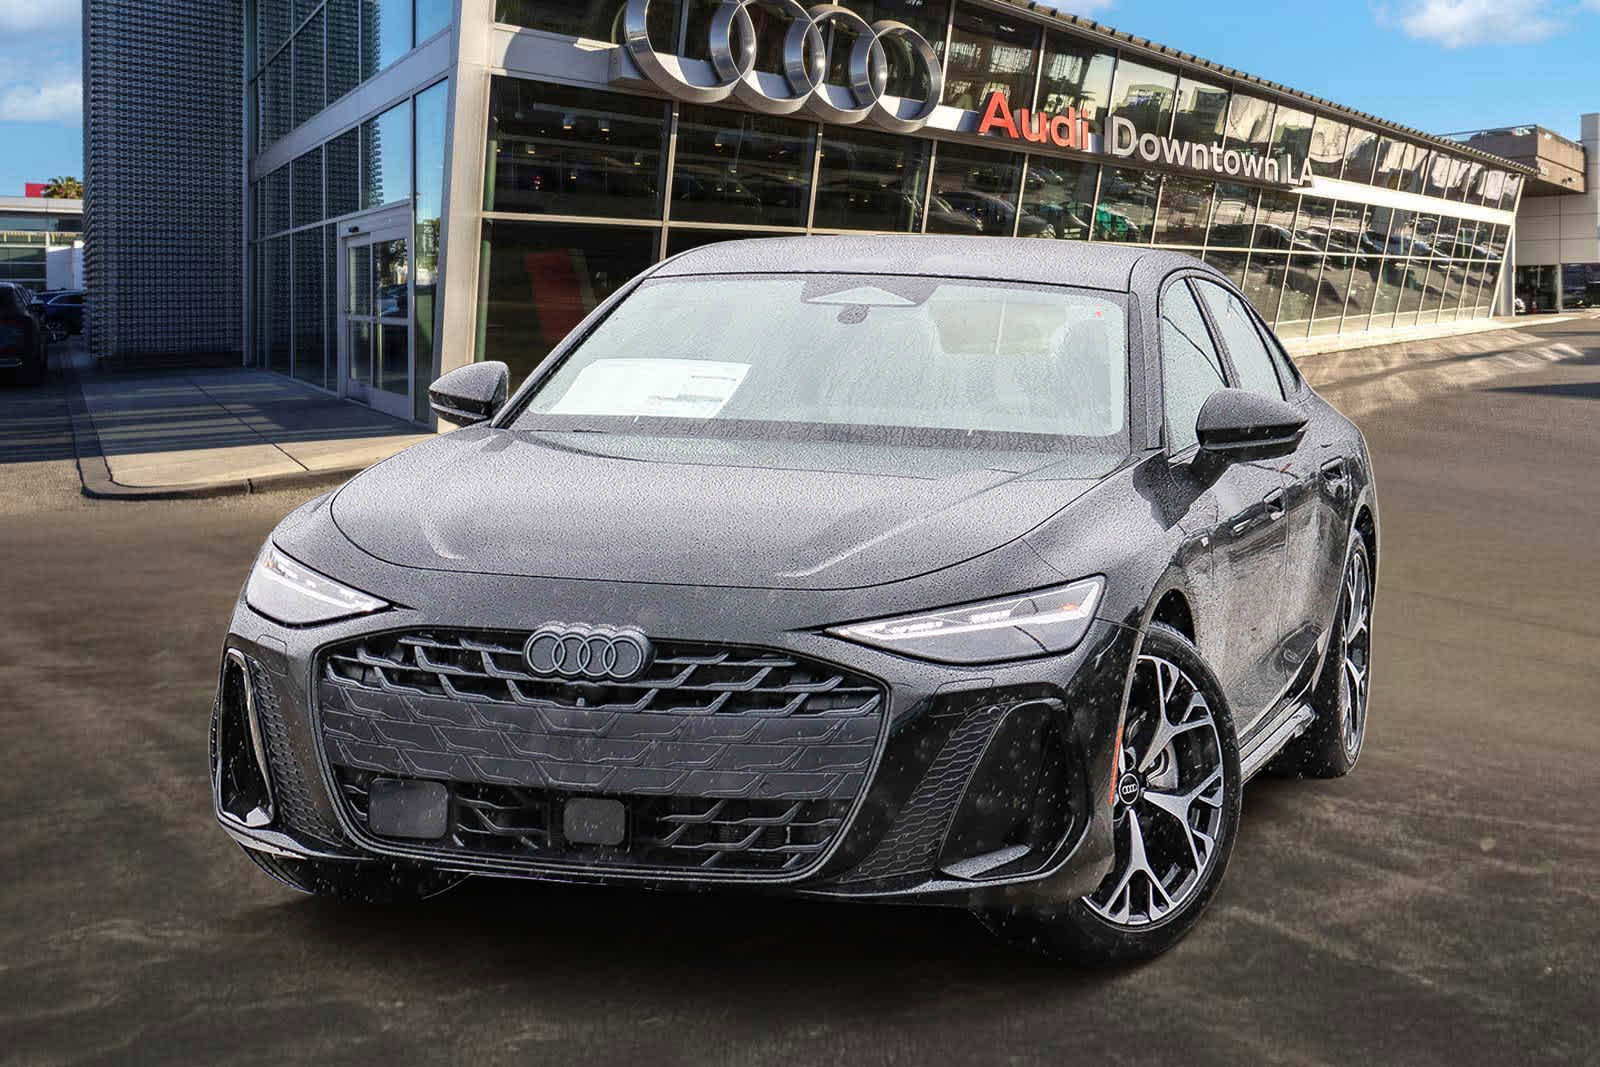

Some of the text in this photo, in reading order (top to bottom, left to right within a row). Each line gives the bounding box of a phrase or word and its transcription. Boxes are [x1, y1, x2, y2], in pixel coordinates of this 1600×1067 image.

[978, 91, 1313, 186] Audi Downtown LA
